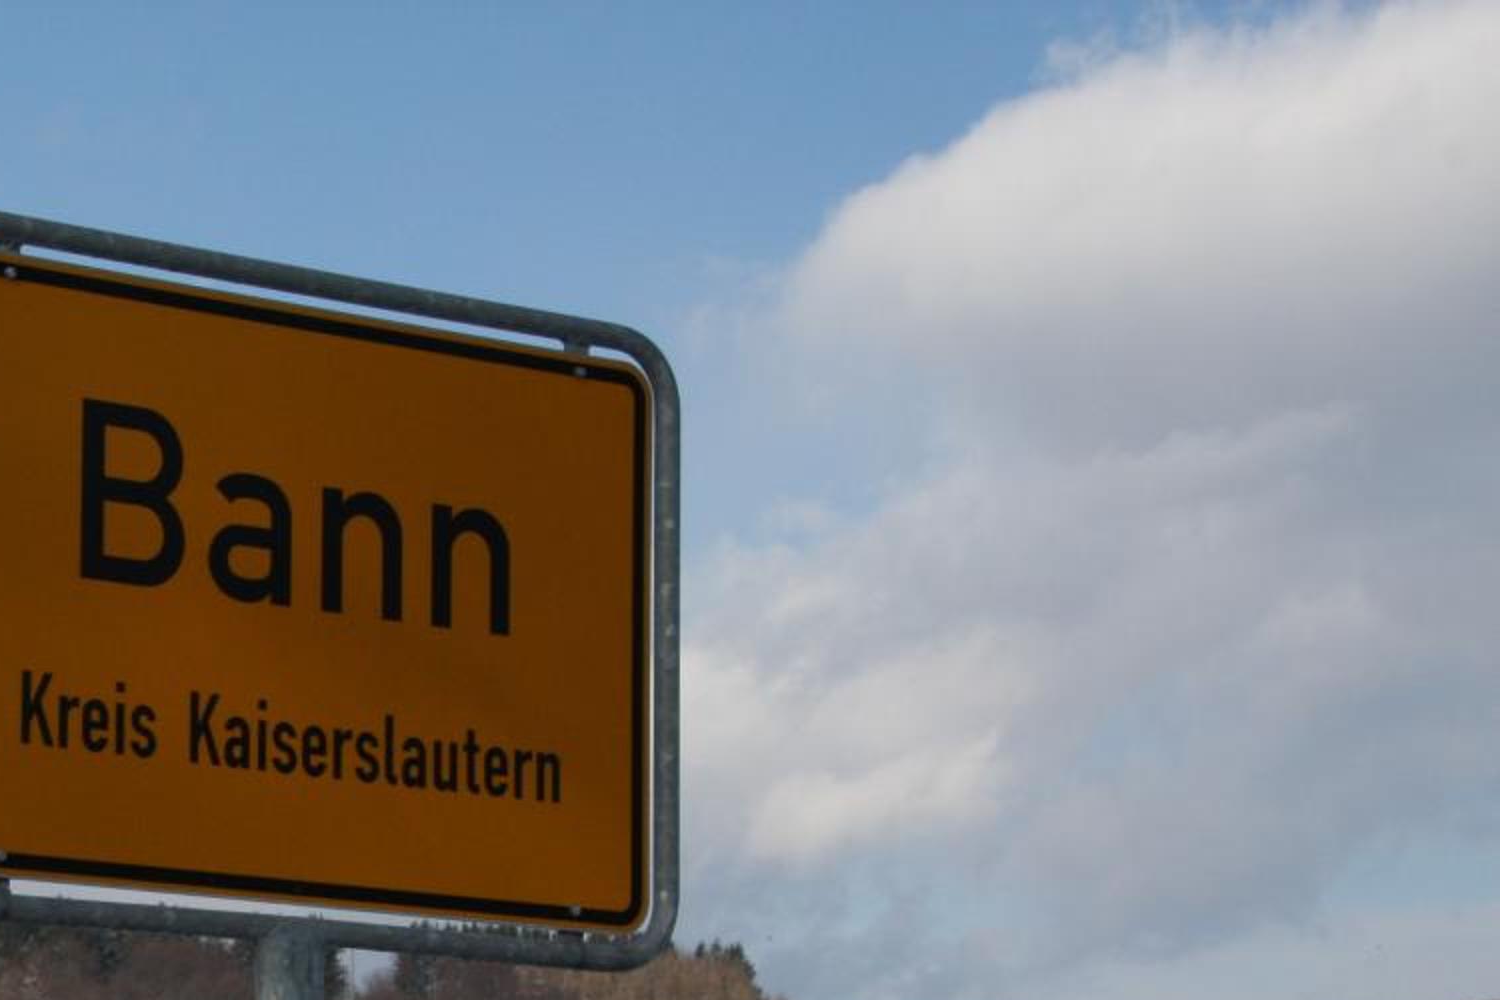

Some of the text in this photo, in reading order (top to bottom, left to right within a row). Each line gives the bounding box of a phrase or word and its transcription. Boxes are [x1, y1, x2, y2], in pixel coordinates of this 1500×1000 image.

[80, 398, 511, 636] Bann
[20, 670, 562, 804] Kreis Kaiserslautern
